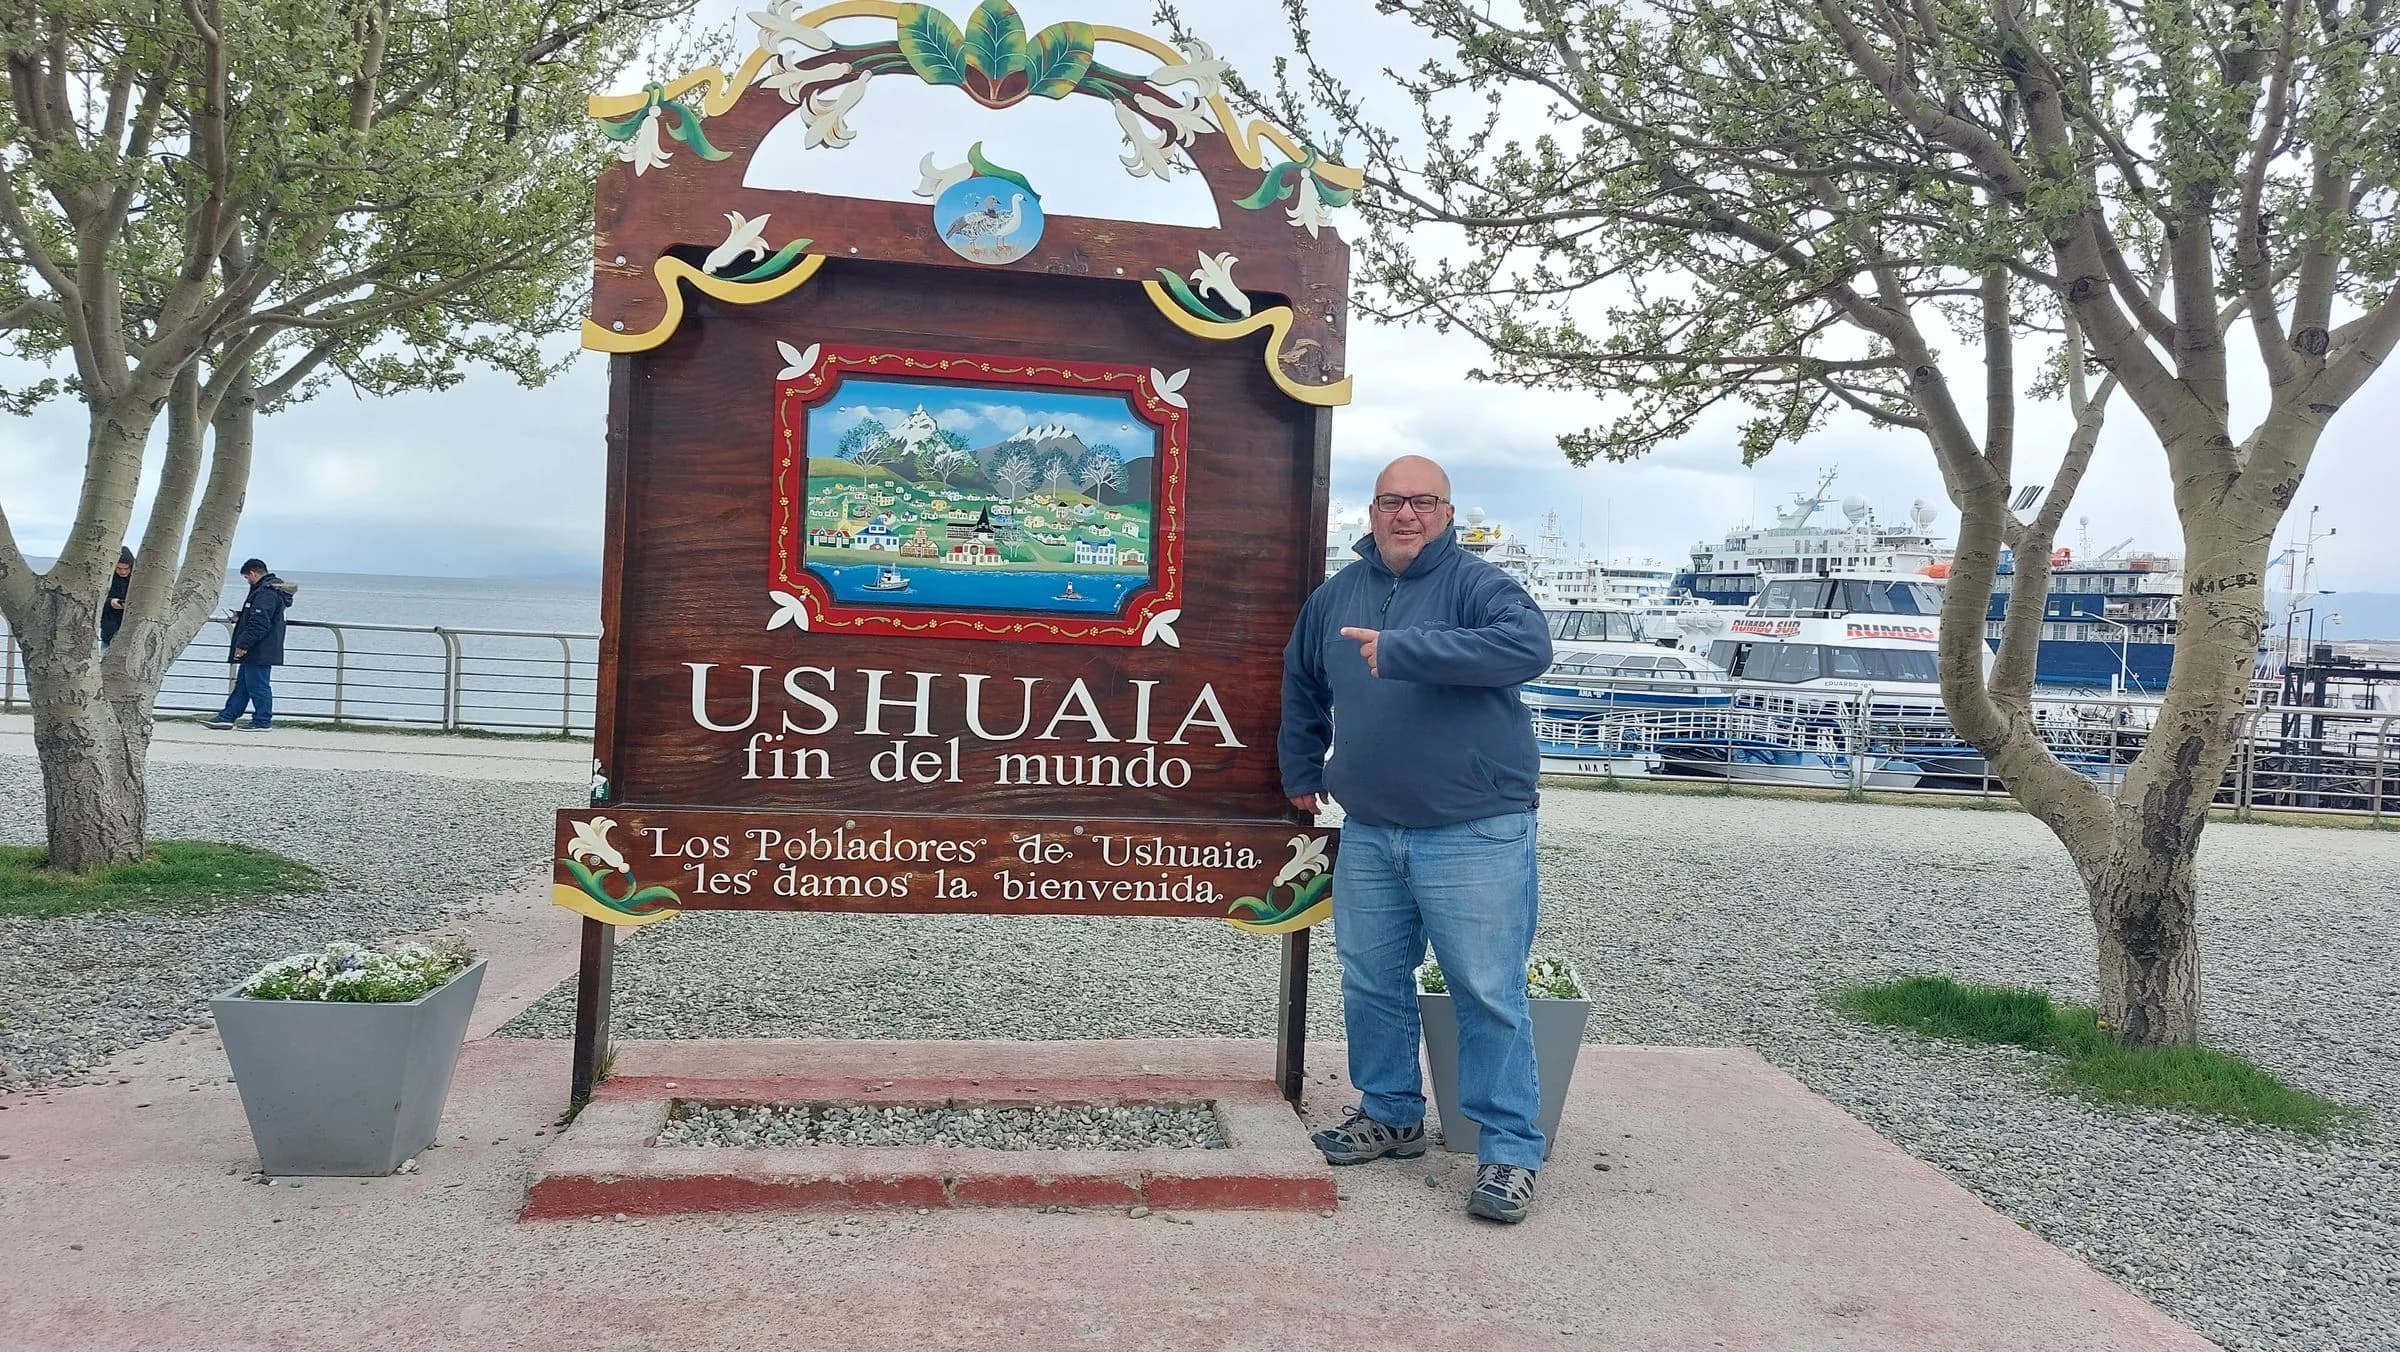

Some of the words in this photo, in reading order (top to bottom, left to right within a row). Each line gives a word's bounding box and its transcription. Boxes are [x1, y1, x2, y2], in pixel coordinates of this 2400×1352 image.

[1731, 619, 1774, 634] RUMBO
[1774, 620, 1801, 635] SUR
[1846, 623, 1936, 640] RUMBO
[682, 663, 1247, 747] USHUAIA
[742, 733, 835, 780] fin
[870, 737, 963, 784] del
[995, 746, 1191, 789] mundo
[640, 827, 730, 859] Los
[745, 827, 987, 864] Pobladores
[1012, 833, 1073, 865] de
[1092, 836, 1262, 869] Ushuaia
[684, 863, 758, 895] les
[773, 863, 912, 898] damos
[934, 869, 978, 899] la
[993, 870, 1224, 904] bienvenida
